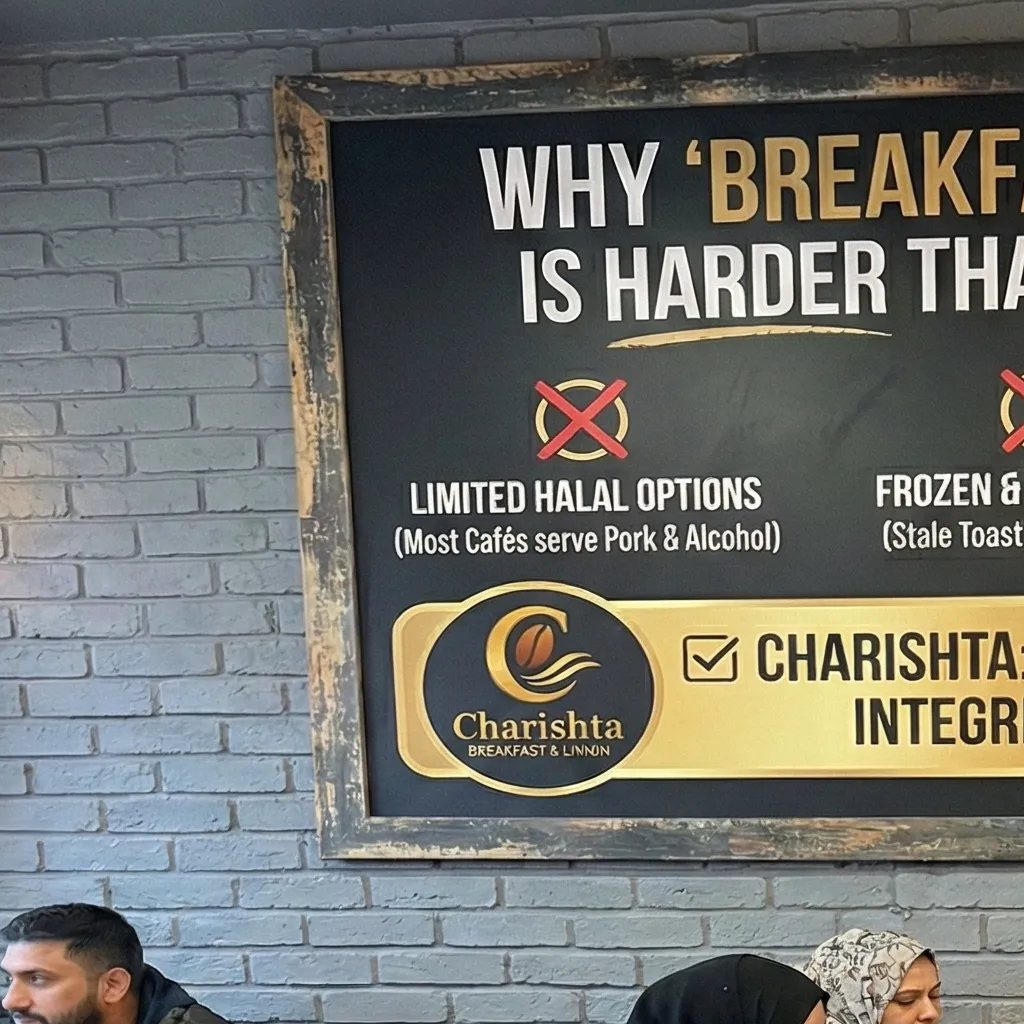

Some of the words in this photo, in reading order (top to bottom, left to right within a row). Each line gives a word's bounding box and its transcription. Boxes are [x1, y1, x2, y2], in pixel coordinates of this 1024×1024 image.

[479, 141, 660, 230] WHY
[520, 248, 582, 324] IS
[605, 240, 888, 321] HARDER
[409, 479, 527, 516] LIMITED
[534, 477, 629, 514] HALAL
[636, 475, 763, 511] OPTIONS
[875, 471, 992, 508] FROZEN
[999, 471, 1021, 506] &
[394, 525, 460, 559] (Most
[465, 523, 529, 555] Cafés
[534, 530, 598, 554] serve
[604, 523, 658, 552] Pork
[663, 523, 680, 551] &
[685, 520, 782, 555] Alcohol)
[882, 520, 952, 553] (Stale
[452, 710, 625, 741] Charishta
[468, 744, 547, 758] BREAKFAST
[550, 744, 560, 757] &
